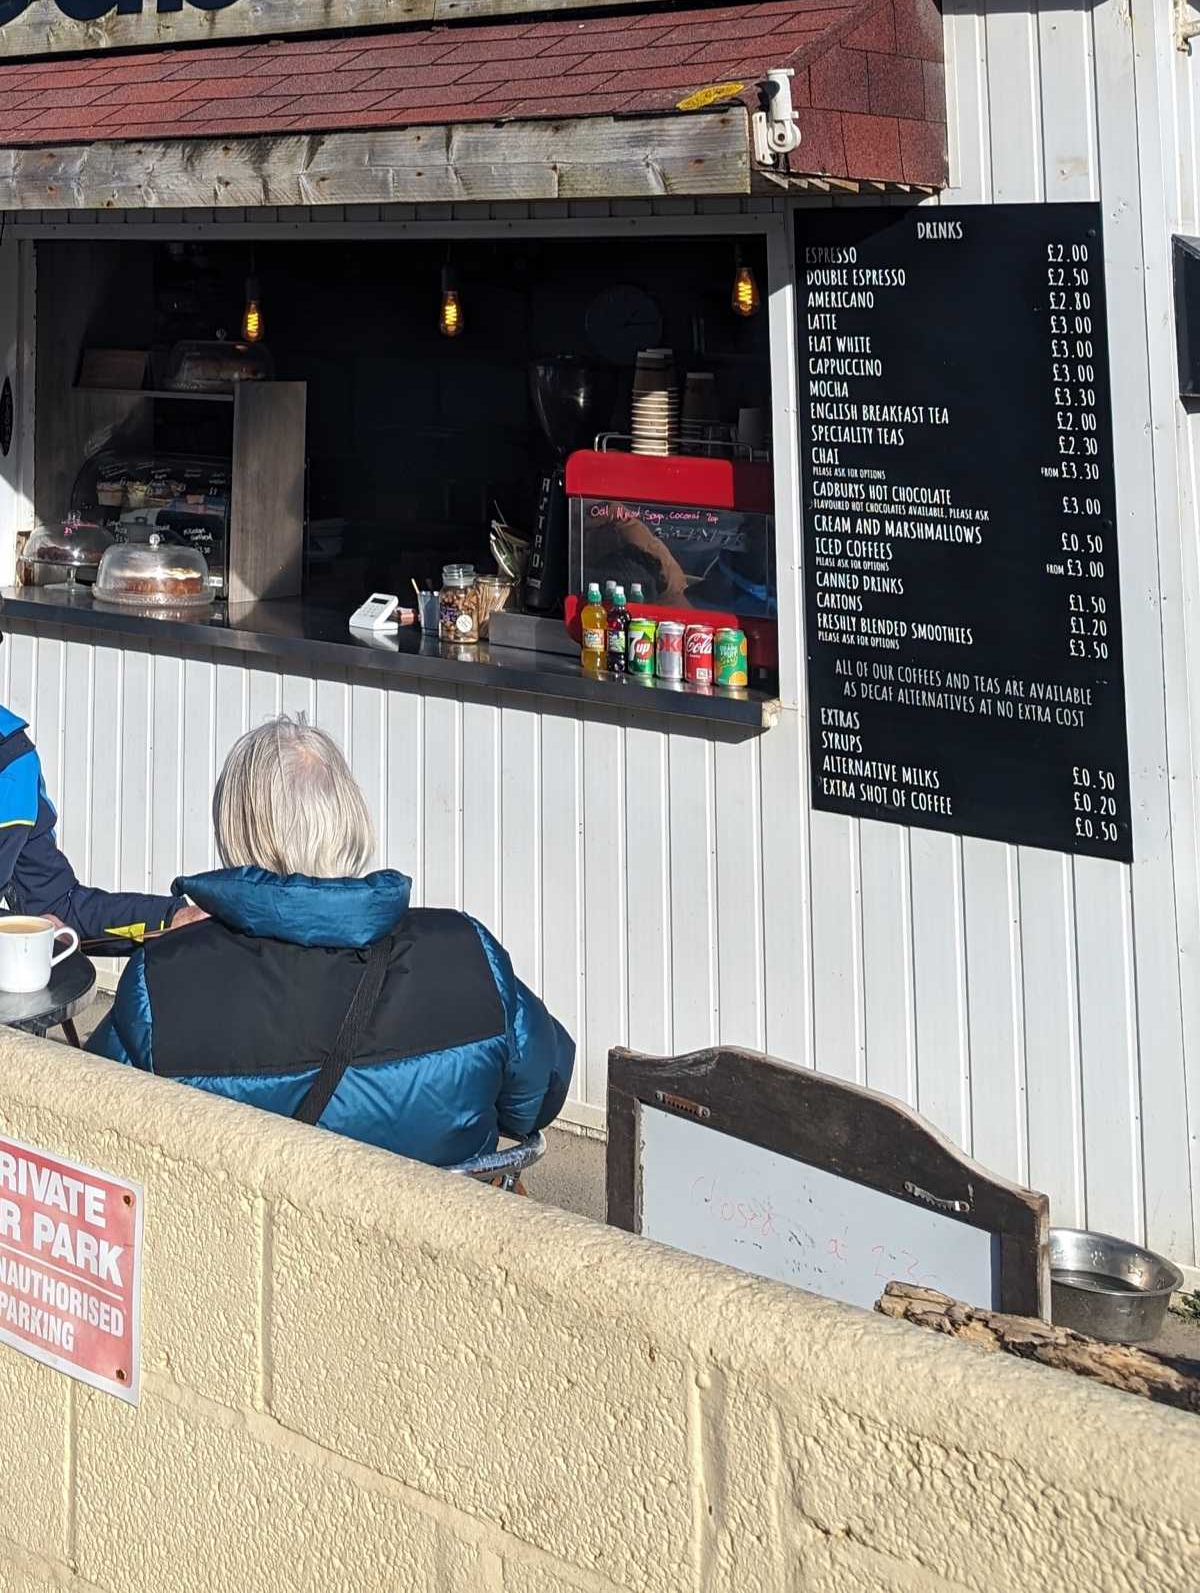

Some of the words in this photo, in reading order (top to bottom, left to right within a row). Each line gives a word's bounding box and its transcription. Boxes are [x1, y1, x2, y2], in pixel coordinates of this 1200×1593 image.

[916, 220, 963, 239] DRINKS
[805, 245, 857, 264] ESPRESSO
[1047, 243, 1088, 262] £2.00
[805, 268, 849, 286] DOUBLE
[852, 267, 906, 286] ESPRESSO
[1047, 267, 1089, 286] £2.50
[807, 290, 874, 309] AMERICANO
[1048, 291, 1091, 311] £2.80
[807, 312, 837, 330] LATTE
[1050, 314, 1092, 334] £3.00
[807, 334, 832, 352] FLAT
[835, 335, 872, 354] WHITE
[1051, 338, 1093, 358] £3.00
[808, 357, 882, 377] CAPPUCCINO
[1052, 362, 1094, 383] £3.00
[808, 379, 849, 398] MOCHA
[1054, 386, 1095, 407] £3.30
[809, 401, 858, 421] ENGLISH
[861, 403, 924, 424] BREAKFAST
[927, 406, 949, 425] TEA
[1056, 410, 1097, 431] £2.00
[810, 423, 873, 444] SPECIALITY
[876, 427, 905, 446] TEAS
[1058, 434, 1098, 456] £2.30
[811, 446, 840, 465] CHAI
[1060, 460, 1099, 480] £3.30
[812, 480, 865, 500] CADBURYS
[868, 483, 888, 501] HOT
[891, 485, 952, 506] CHOCOLATE
[1062, 495, 1101, 515] £3.00
[813, 513, 851, 534] CREAM
[854, 517, 880, 536] AND
[884, 519, 982, 545] MARSHMALLOWS
[1061, 531, 1103, 554] £0.50
[814, 536, 842, 556] ICED
[845, 539, 893, 560] COFFEES
[1066, 558, 1104, 578] £3.00
[815, 570, 859, 590] CANNED
[862, 574, 904, 595] DRINKS
[1068, 593, 1106, 614] £1.50
[815, 591, 863, 612] CARTONS
[1070, 615, 1107, 637] £1.20
[816, 611, 856, 632] FRESHLY
[860, 616, 907, 637] BLENDED
[910, 621, 973, 645] SMOOTHIES
[1069, 638, 1108, 659] £3.50
[834, 658, 853, 676] ALL
[855, 660, 868, 677] OF
[872, 662, 895, 681] OUR
[897, 665, 941, 687] COFFEES
[945, 671, 970, 690] AND
[973, 674, 1000, 695] TEAS
[1004, 678, 1025, 697] ARE
[1029, 682, 1092, 706] AVAILABLE
[820, 706, 860, 730] EXTRAS
[843, 680, 857, 698] AS
[860, 681, 893, 702] DECAF
[897, 687, 975, 713] ALTERNATIVES
[978, 698, 992, 715] AT
[996, 699, 1014, 719] NO
[1017, 702, 1051, 723] EXTRA
[1055, 707, 1084, 727] COST
[821, 730, 863, 753] SYRUPS
[1072, 765, 1115, 791] £0.50
[822, 754, 898, 782] ALTERNATIVE
[901, 765, 940, 789] MILKS
[1073, 790, 1116, 816] £0.20
[823, 778, 856, 799] EXTRA
[859, 782, 888, 806] SHOT
[891, 787, 906, 807] OF
[910, 791, 953, 816] COFFEE
[1074, 816, 1118, 842] £0.50
[33, 1211, 123, 1287] PARK
